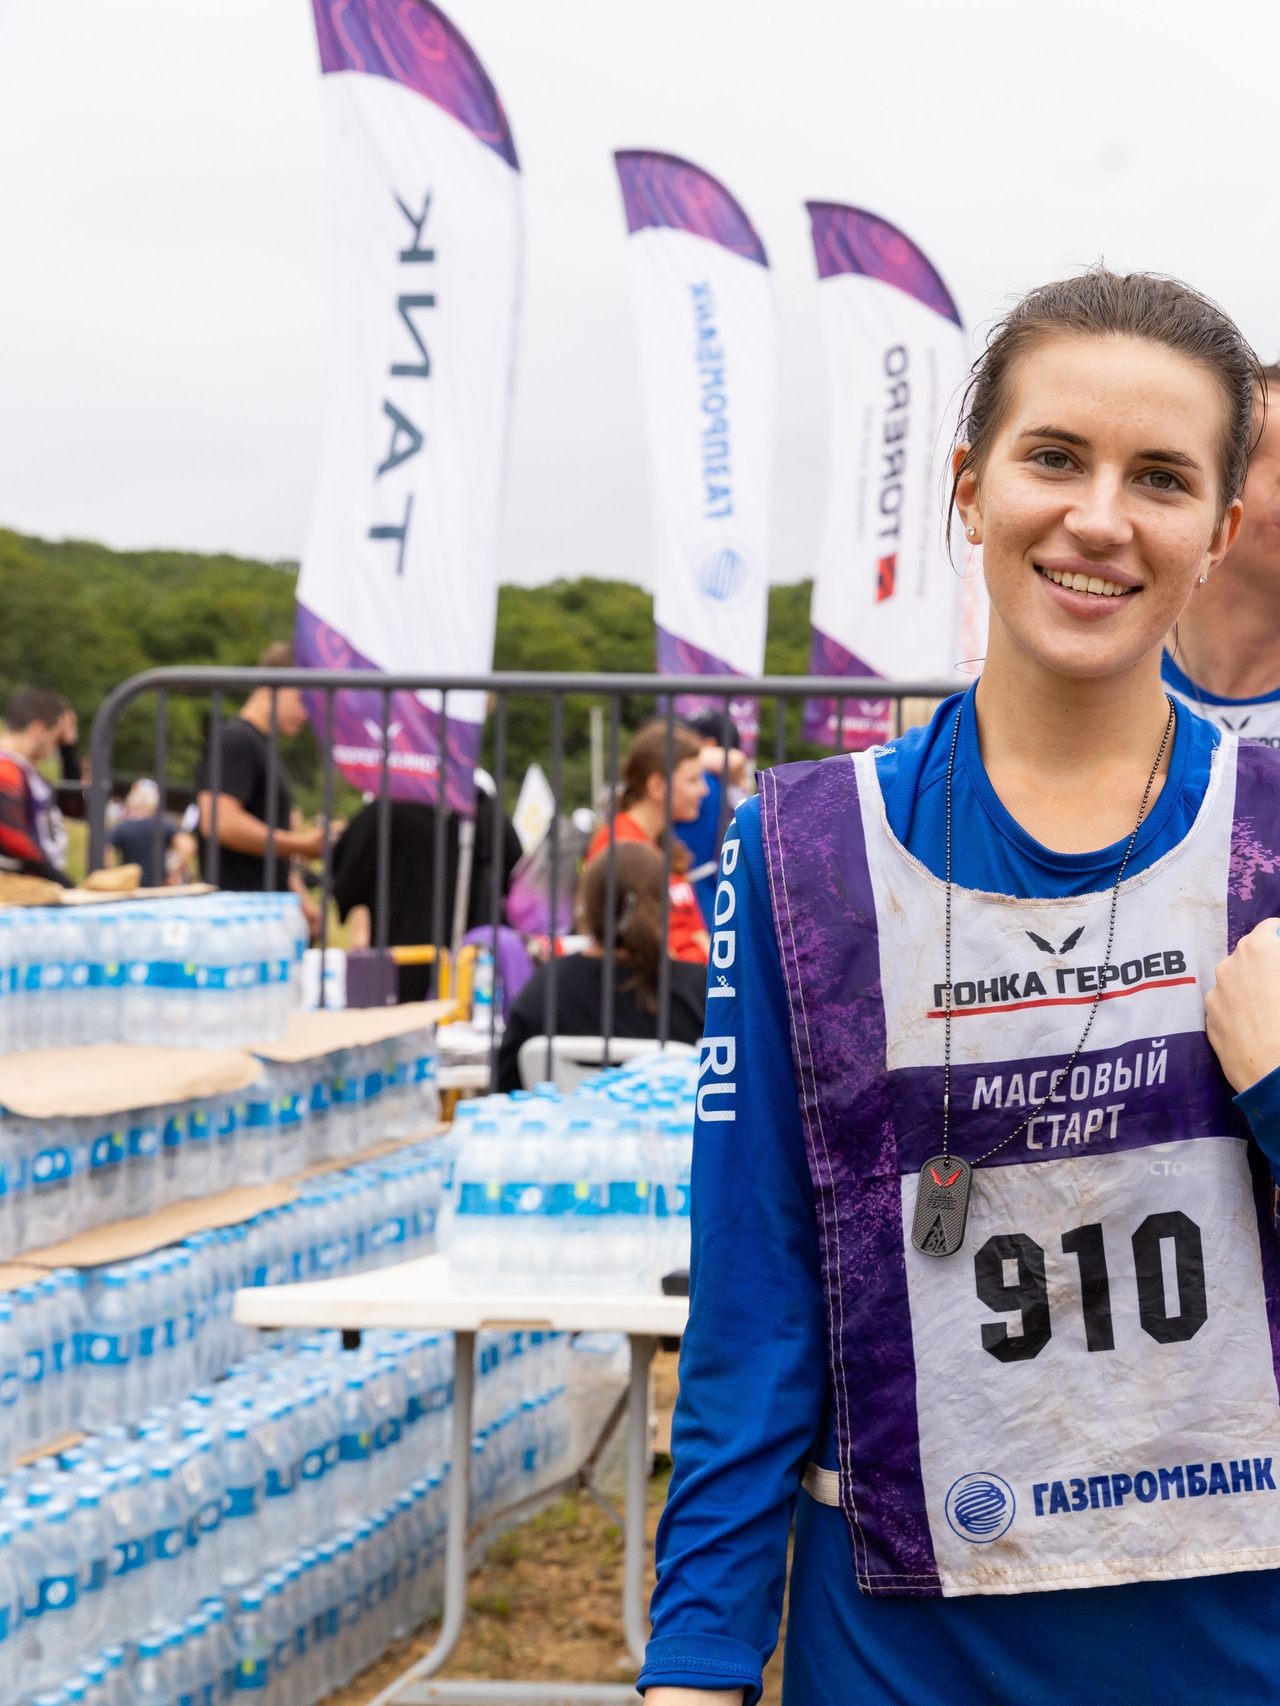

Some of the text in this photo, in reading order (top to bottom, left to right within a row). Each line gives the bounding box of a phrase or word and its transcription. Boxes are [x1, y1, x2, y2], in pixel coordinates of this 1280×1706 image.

[933, 949, 1188, 1008] ГОНКА ГЕРОЕВ
[971, 1038, 1168, 1111] МАССОВЫЙ
[1025, 1103, 1126, 1150] СТАРТ
[974, 1210, 1208, 1363] 910
[1032, 1457, 1277, 1517] ГАЗПРОМБАНК
